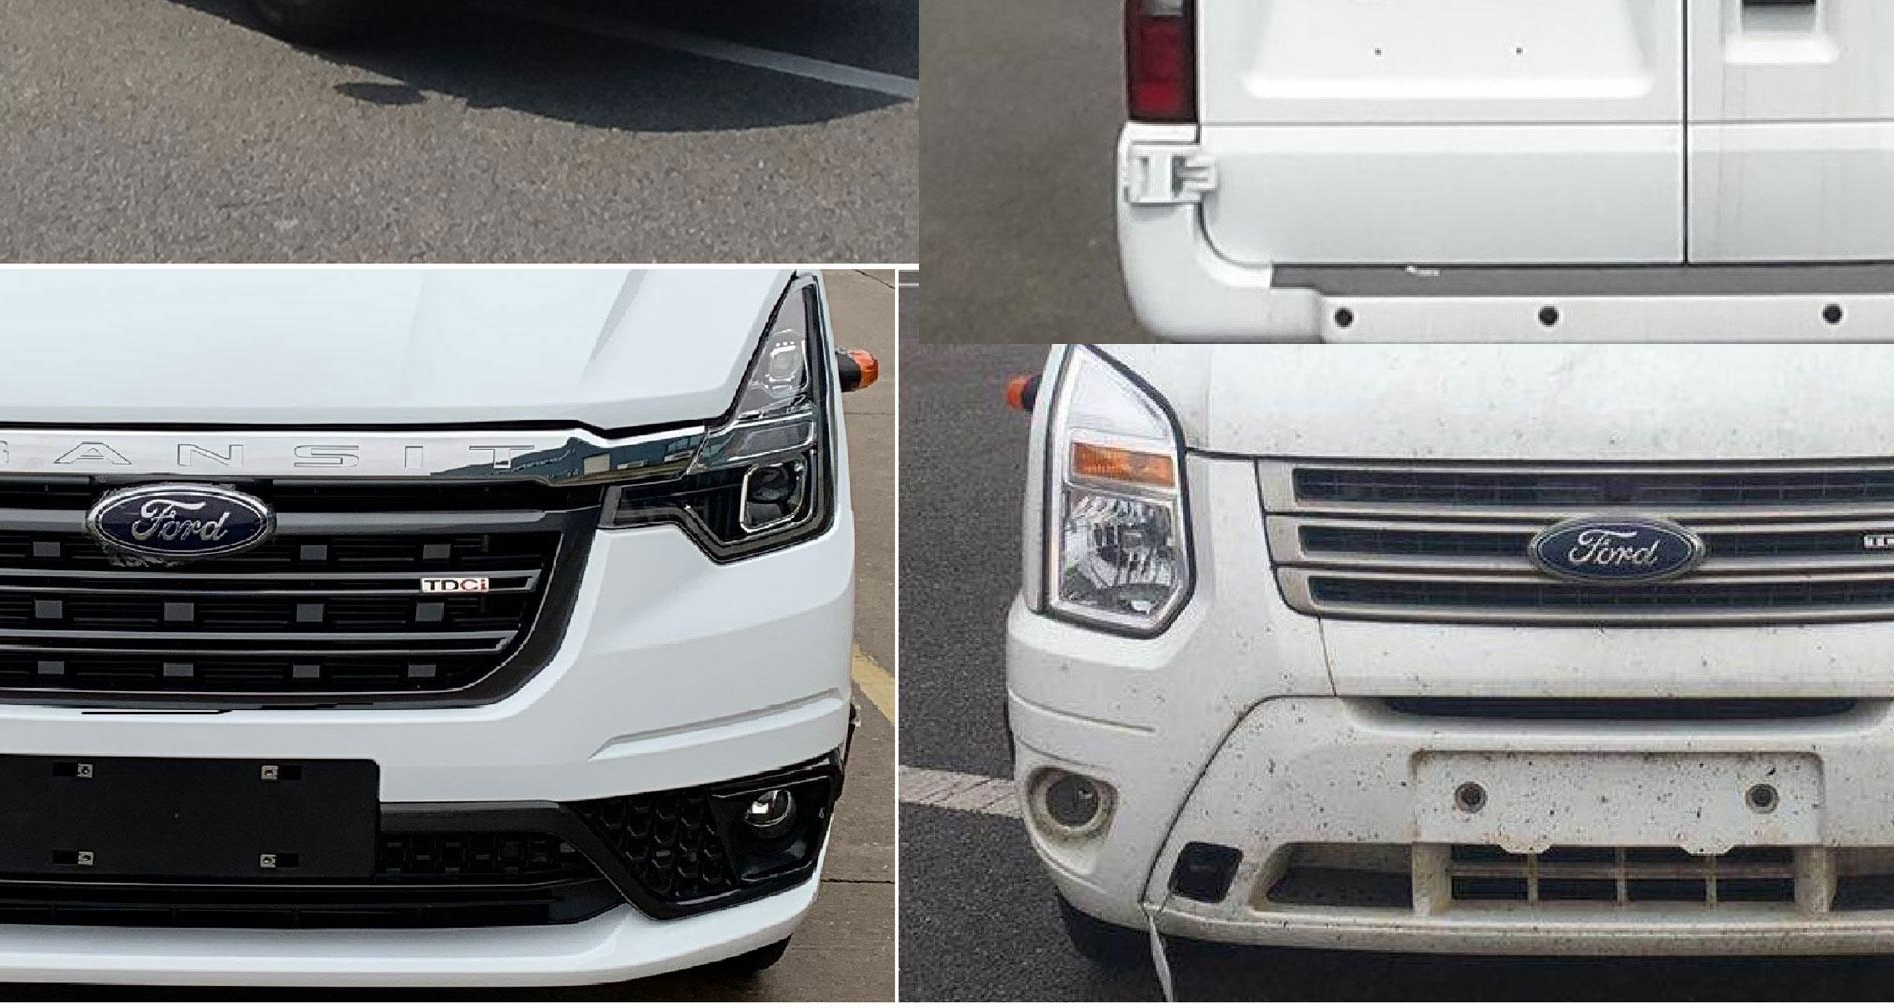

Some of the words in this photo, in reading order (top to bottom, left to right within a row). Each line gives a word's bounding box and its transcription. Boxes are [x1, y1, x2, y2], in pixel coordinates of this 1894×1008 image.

[131, 499, 230, 542] Ford
[1567, 528, 1662, 565] Ford
[422, 578, 489, 593] TDCi
